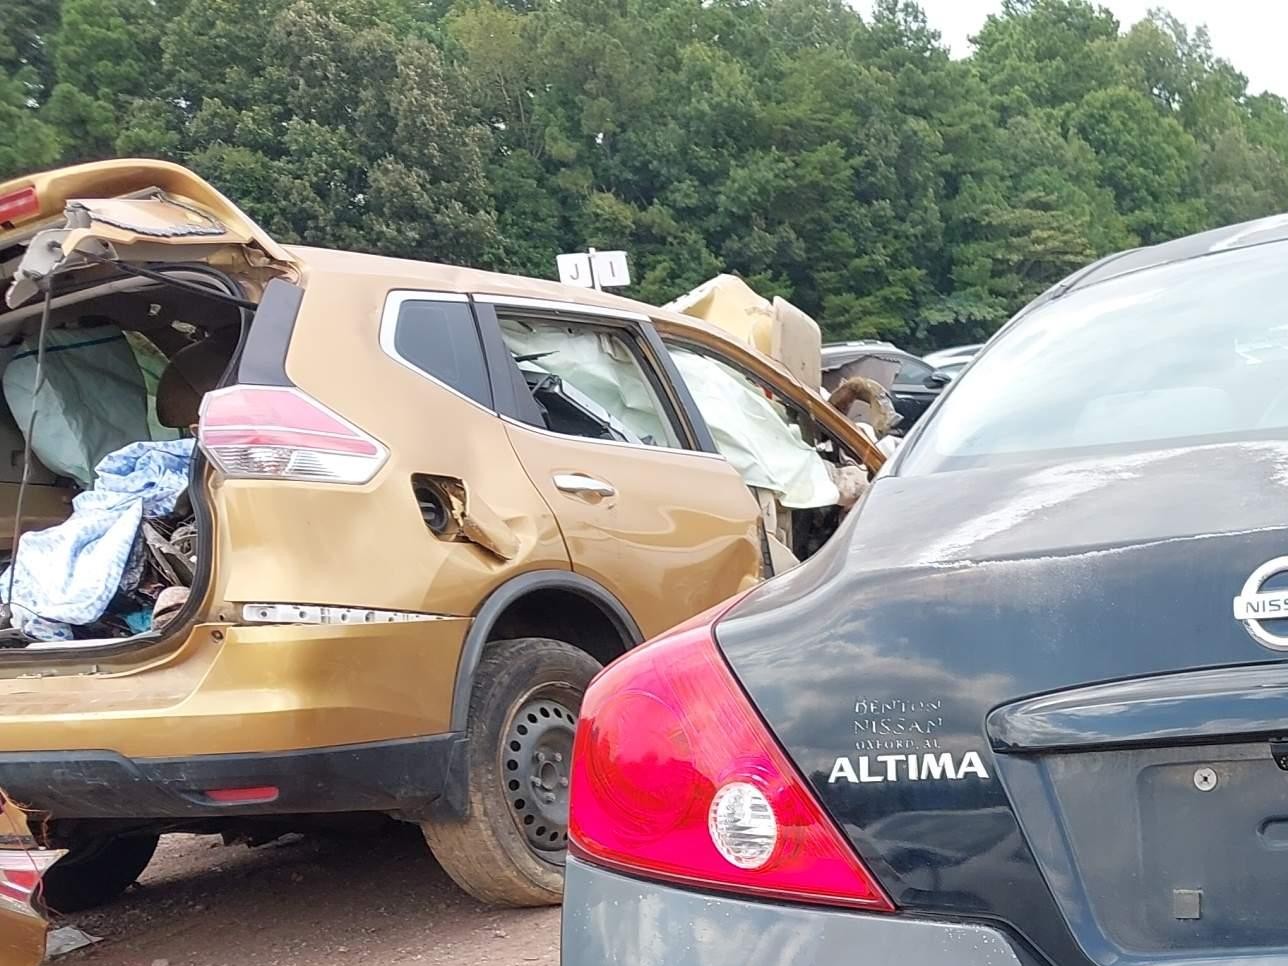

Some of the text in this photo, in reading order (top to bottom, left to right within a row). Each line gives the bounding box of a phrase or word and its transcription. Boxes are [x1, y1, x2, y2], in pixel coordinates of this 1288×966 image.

[570, 263, 580, 280] J
[853, 717, 942, 735] NISSAN
[828, 751, 990, 784] ALTIMA
